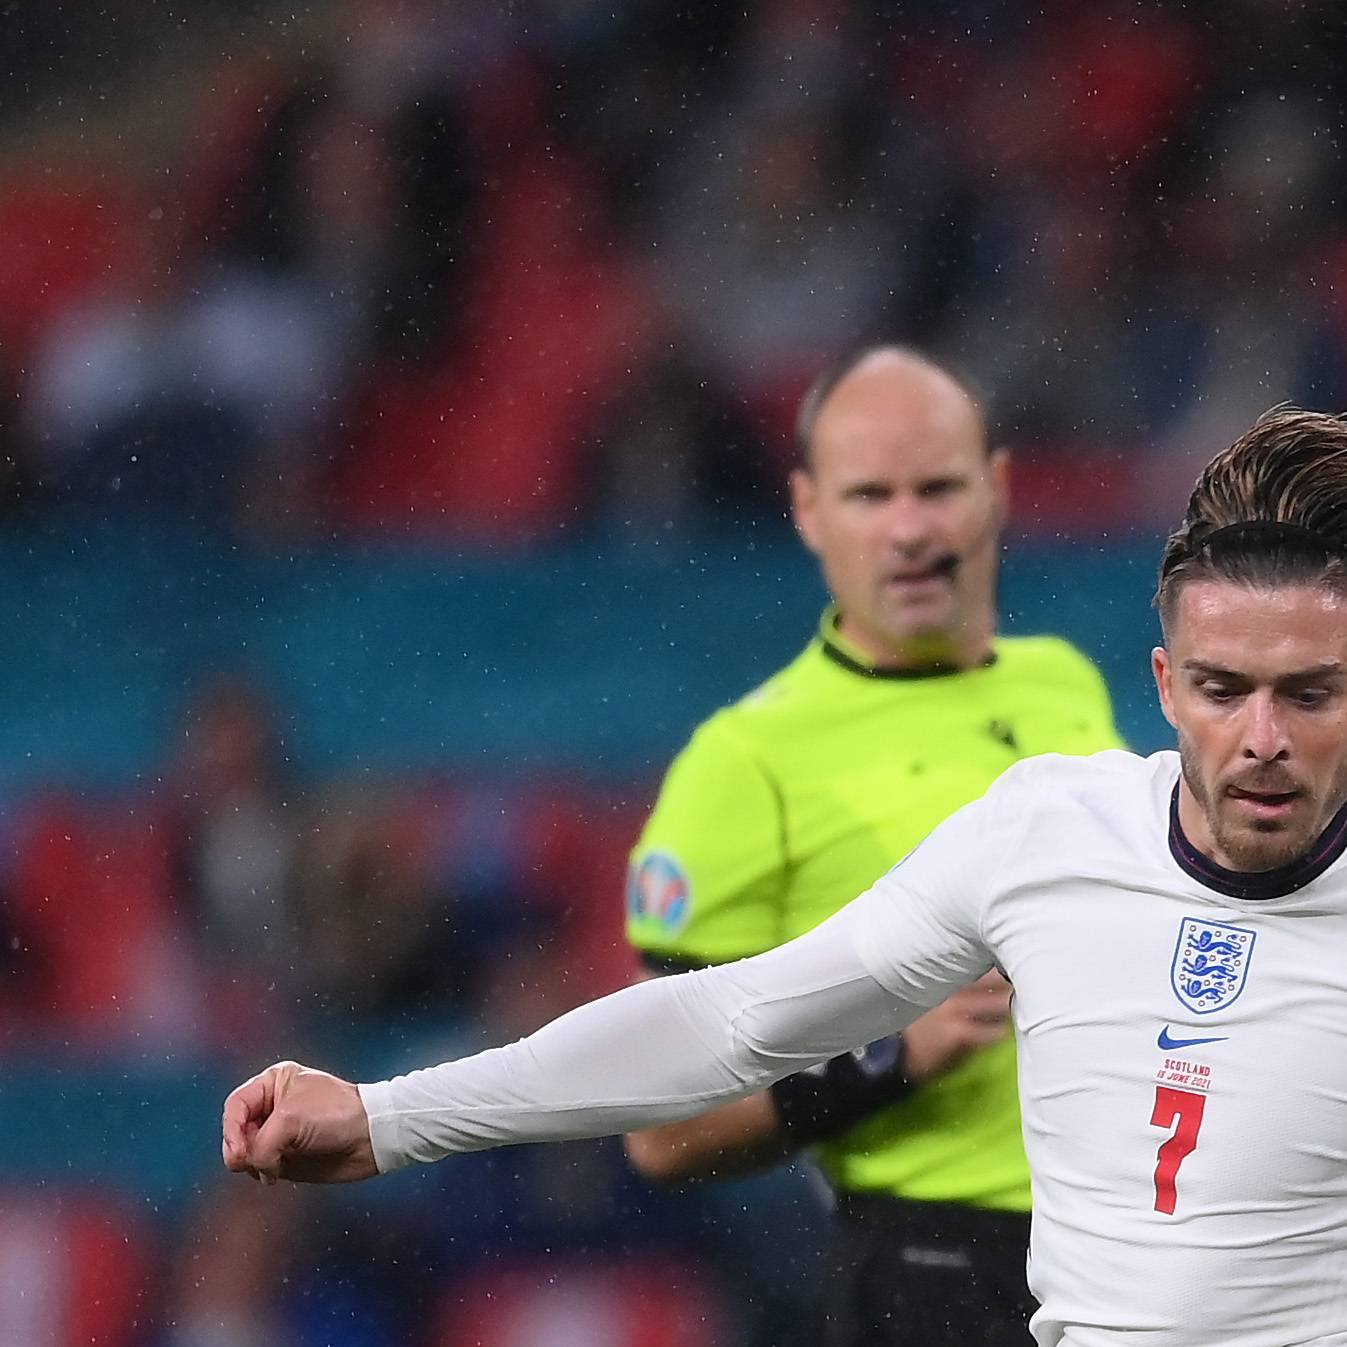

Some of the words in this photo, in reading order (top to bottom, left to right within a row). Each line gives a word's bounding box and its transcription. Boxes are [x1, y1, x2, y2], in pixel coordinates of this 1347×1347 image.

[1164, 1059, 1211, 1077] SCOTLAND
[1167, 1072, 1191, 1084] JUNE
[1191, 1076, 1211, 1089] 2021
[1150, 1086, 1206, 1216] 7
